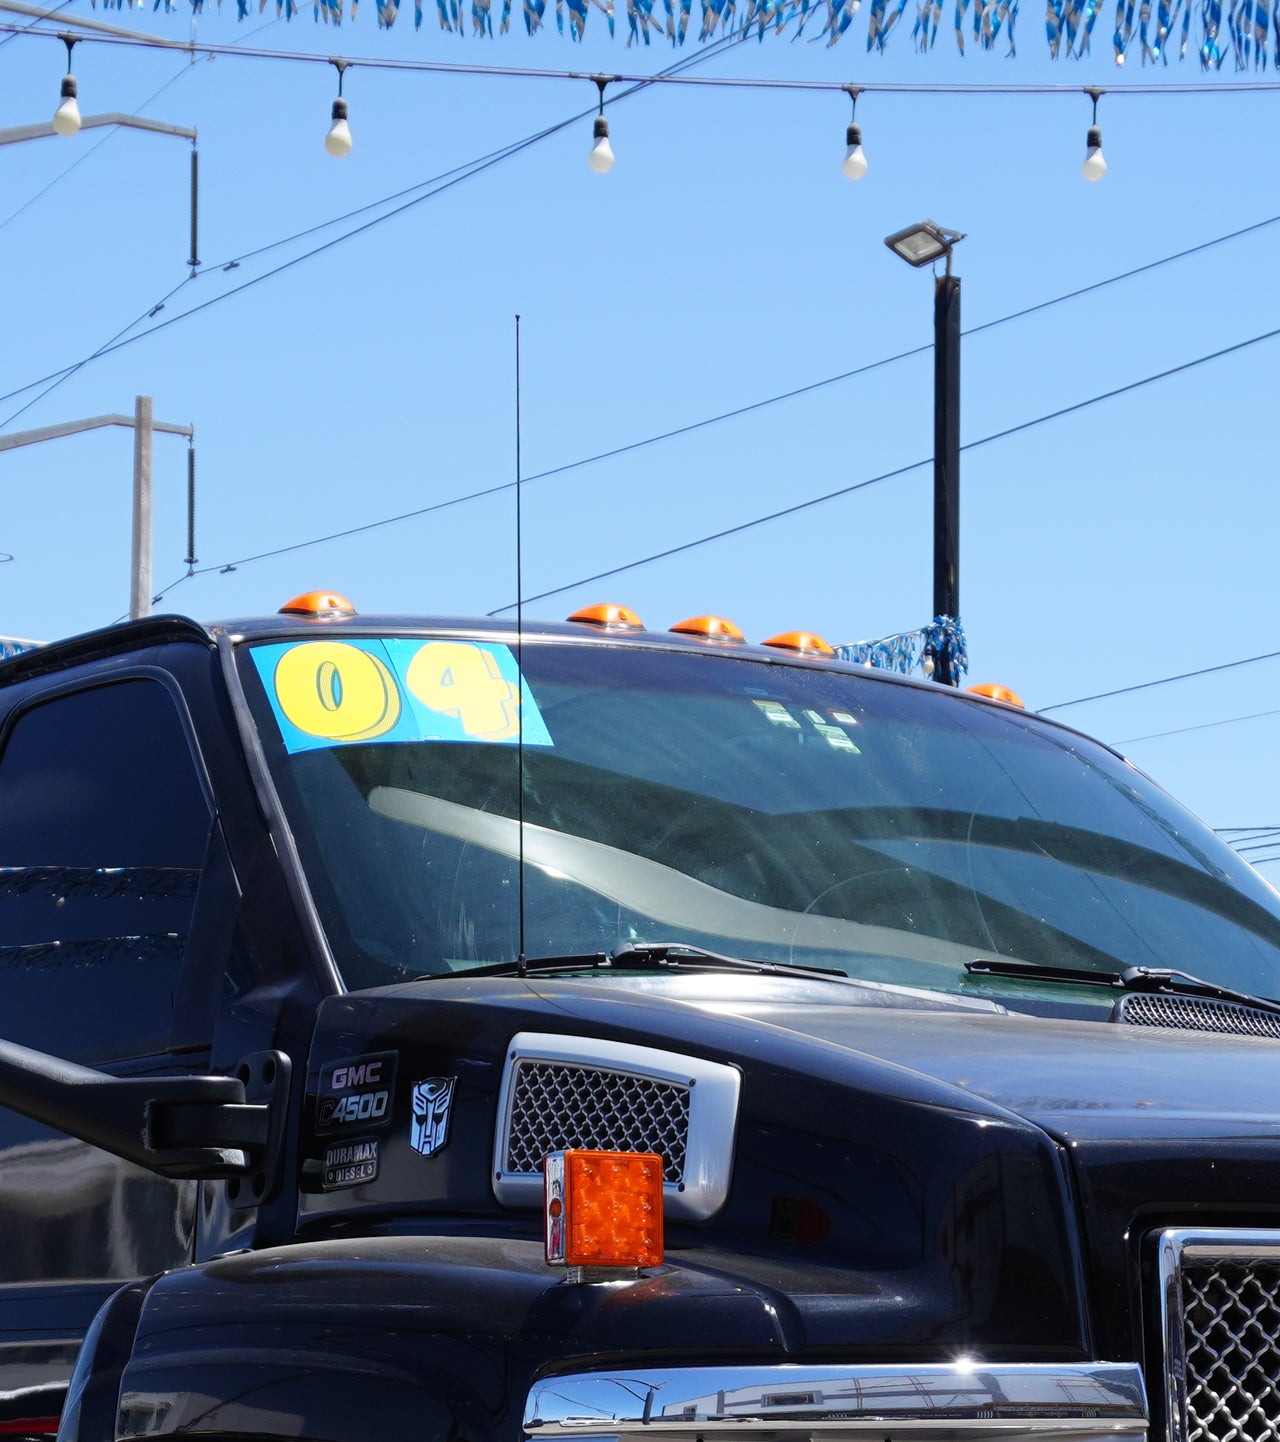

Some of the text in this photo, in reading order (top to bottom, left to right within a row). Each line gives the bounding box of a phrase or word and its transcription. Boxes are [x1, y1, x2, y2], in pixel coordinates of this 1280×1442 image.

[275, 641, 522, 742] 04
[331, 1061, 383, 1090] GMC
[318, 1090, 389, 1127] C4500
[325, 1141, 378, 1167] DURAMAX
[335, 1164, 366, 1182] DIESEL
